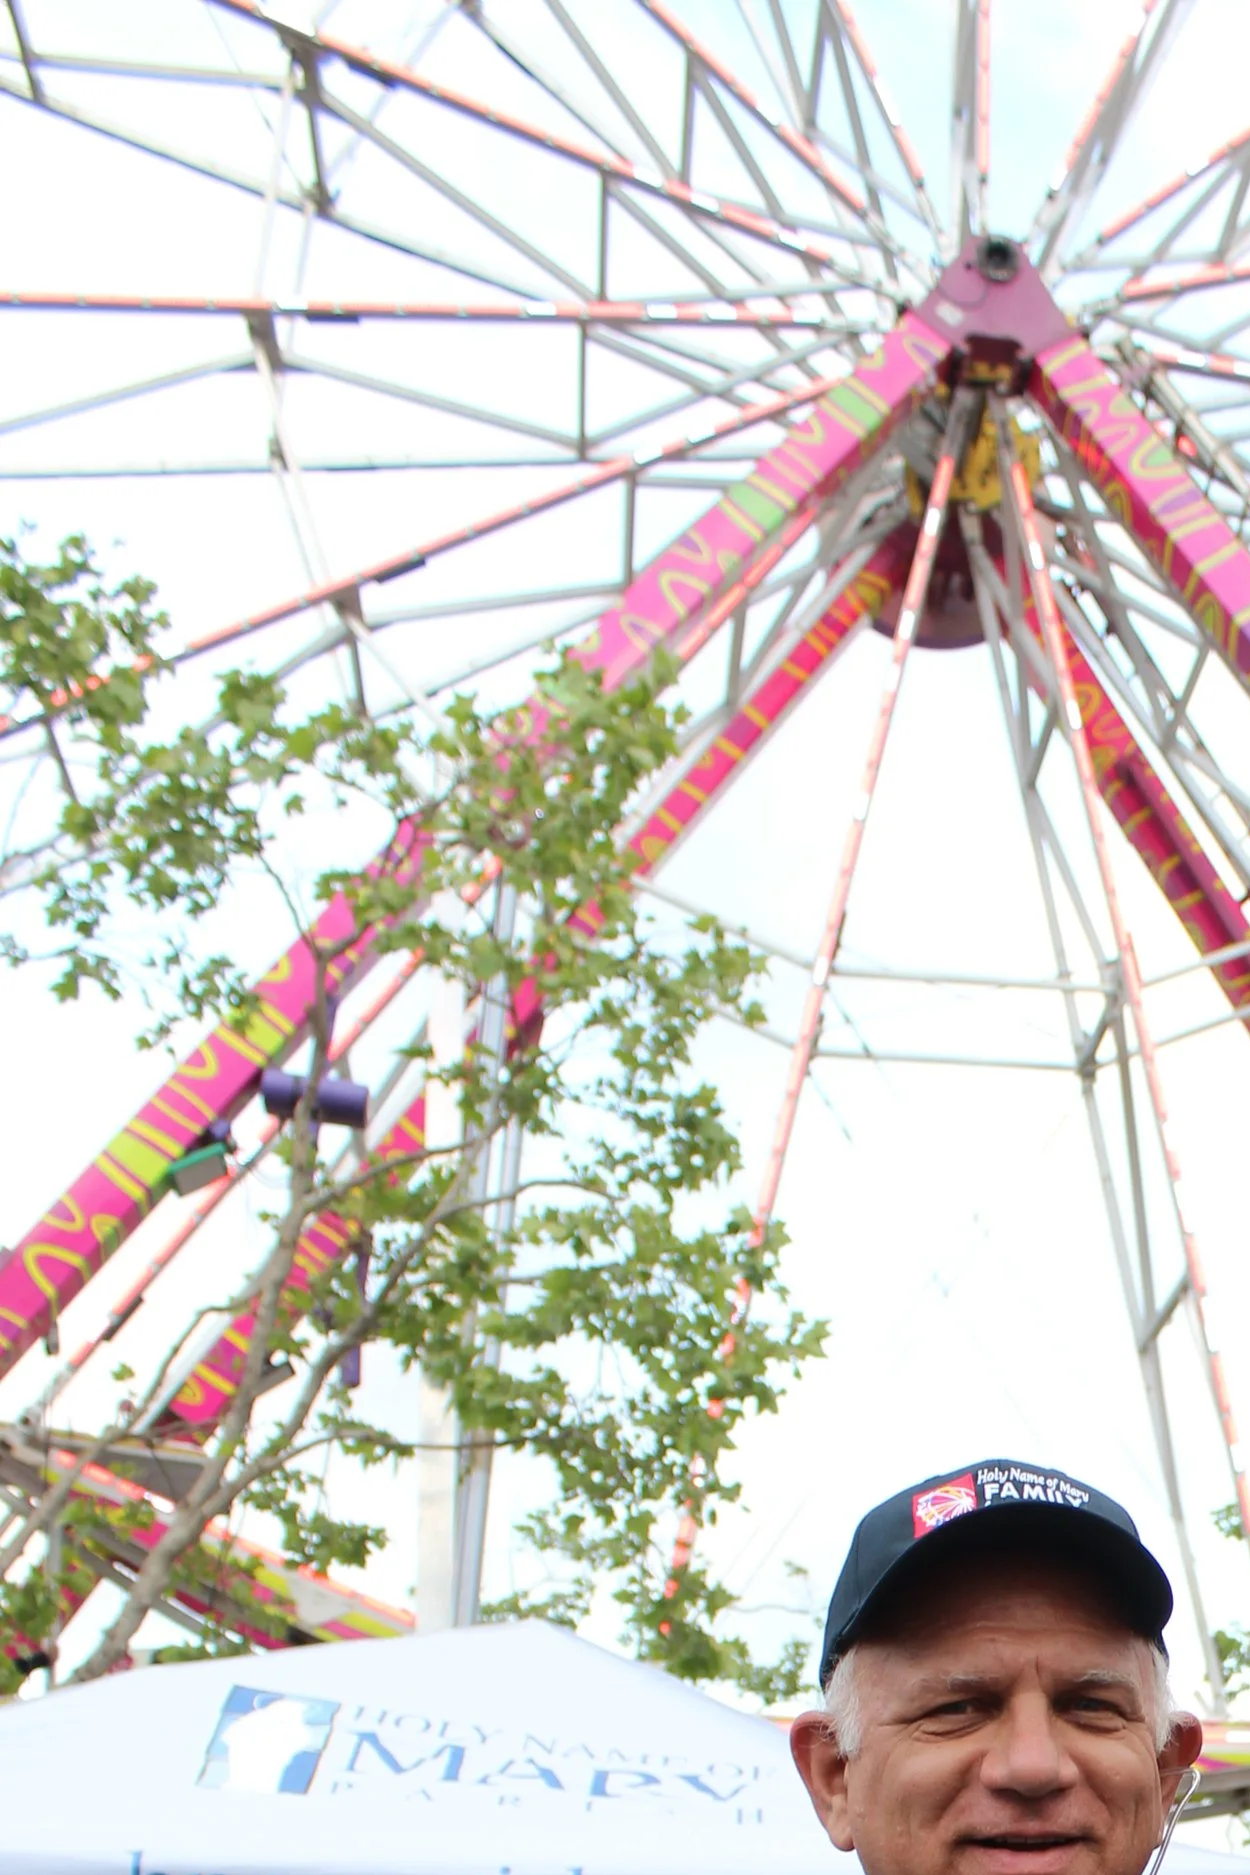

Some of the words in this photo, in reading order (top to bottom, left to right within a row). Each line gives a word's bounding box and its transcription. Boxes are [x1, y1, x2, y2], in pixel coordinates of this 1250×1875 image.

[977, 1466, 1009, 1485] Holy
[1009, 1466, 1045, 1486] Name
[1045, 1477, 1058, 1490] of
[1059, 1479, 1089, 1503] Mary
[352, 1705, 504, 1745] HOLY
[520, 1732, 688, 1765] NAME
